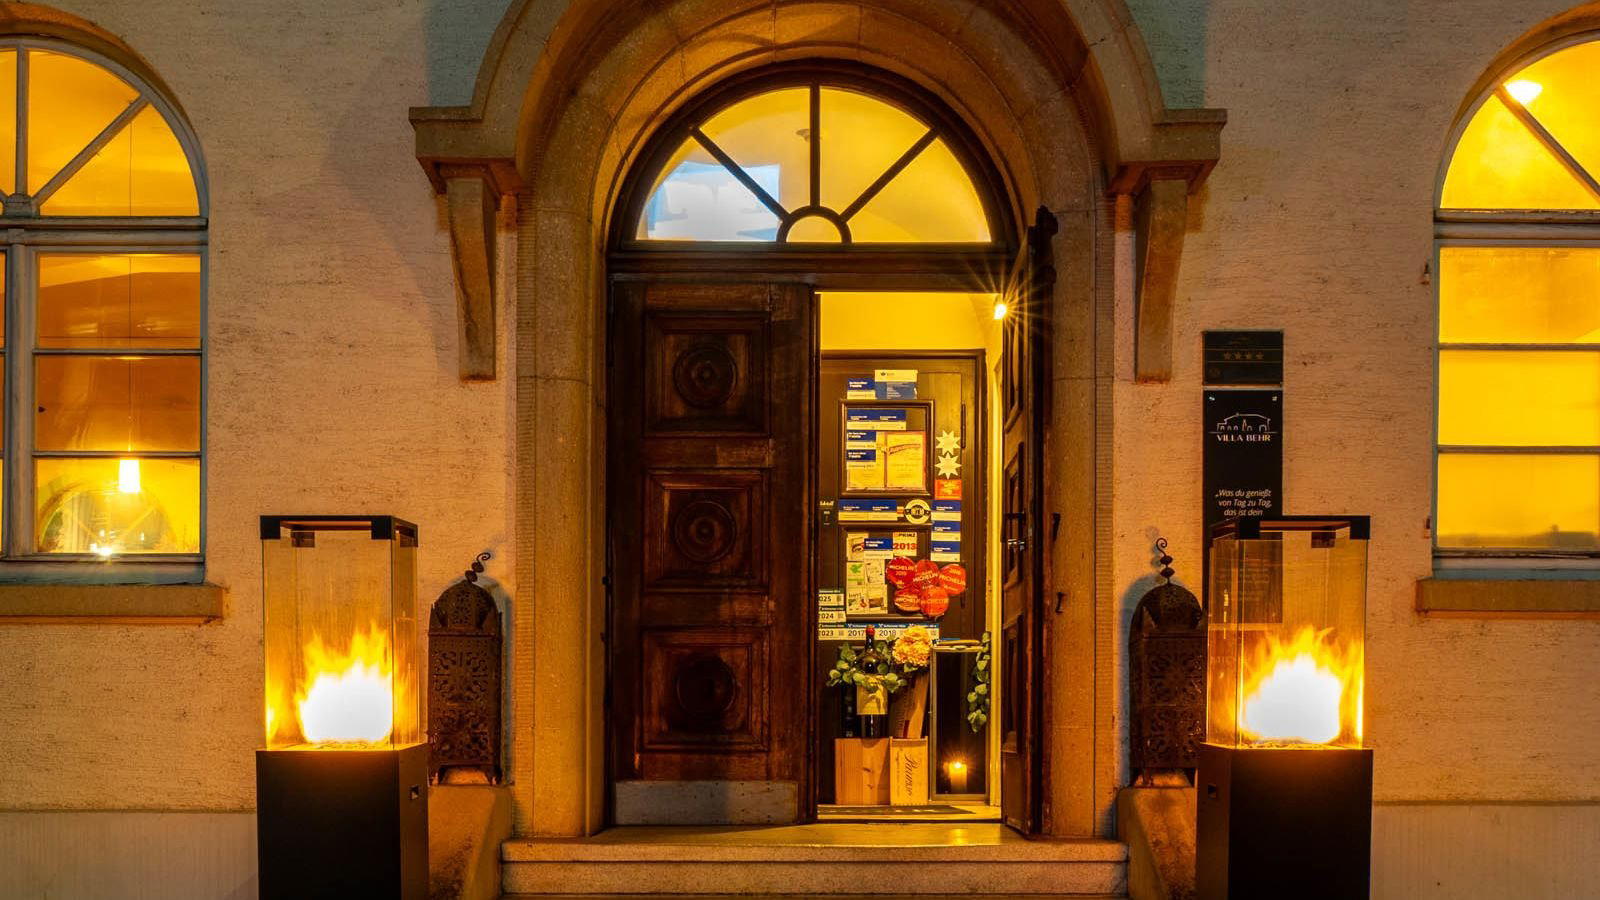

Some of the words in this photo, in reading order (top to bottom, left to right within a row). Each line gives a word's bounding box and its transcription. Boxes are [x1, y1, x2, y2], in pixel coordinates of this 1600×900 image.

[1216, 434, 1244, 442] VILLA
[1246, 434, 1271, 442] BEHR
[1235, 489, 1245, 497] du
[1245, 489, 1272, 499] genießt
[1233, 499, 1247, 509] Tag
[893, 542, 916, 550] 2013
[912, 572, 939, 583] MICHELIN
[938, 573, 967, 586] MICHELIN
[818, 612, 834, 620] 024
[818, 629, 834, 637] 023
[847, 629, 865, 637] 2017
[879, 629, 897, 637] 2018
